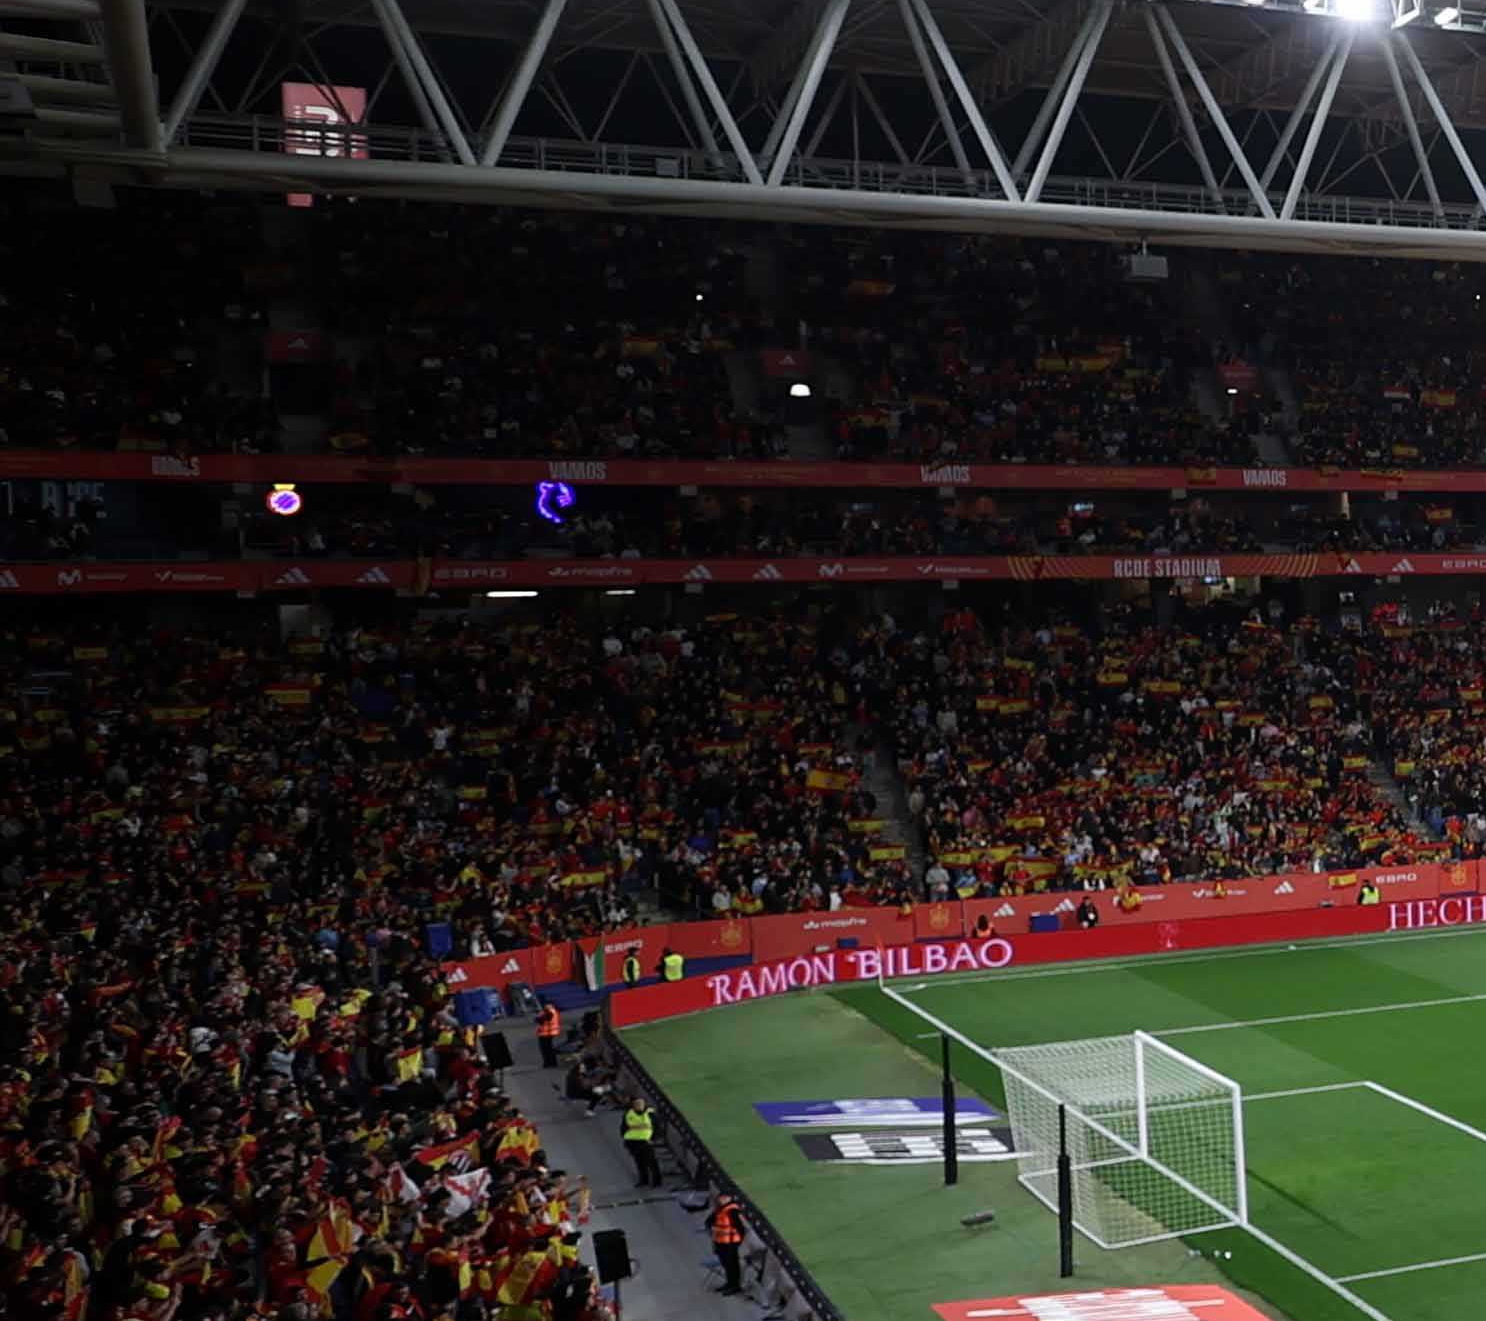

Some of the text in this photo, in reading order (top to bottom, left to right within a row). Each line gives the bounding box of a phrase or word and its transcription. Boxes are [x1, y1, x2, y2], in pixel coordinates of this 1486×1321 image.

[1243, 470, 1287, 487] VAMOS
[1113, 558, 1222, 578] RCDE STADIUM
[846, 937, 1014, 980] BILBAO
